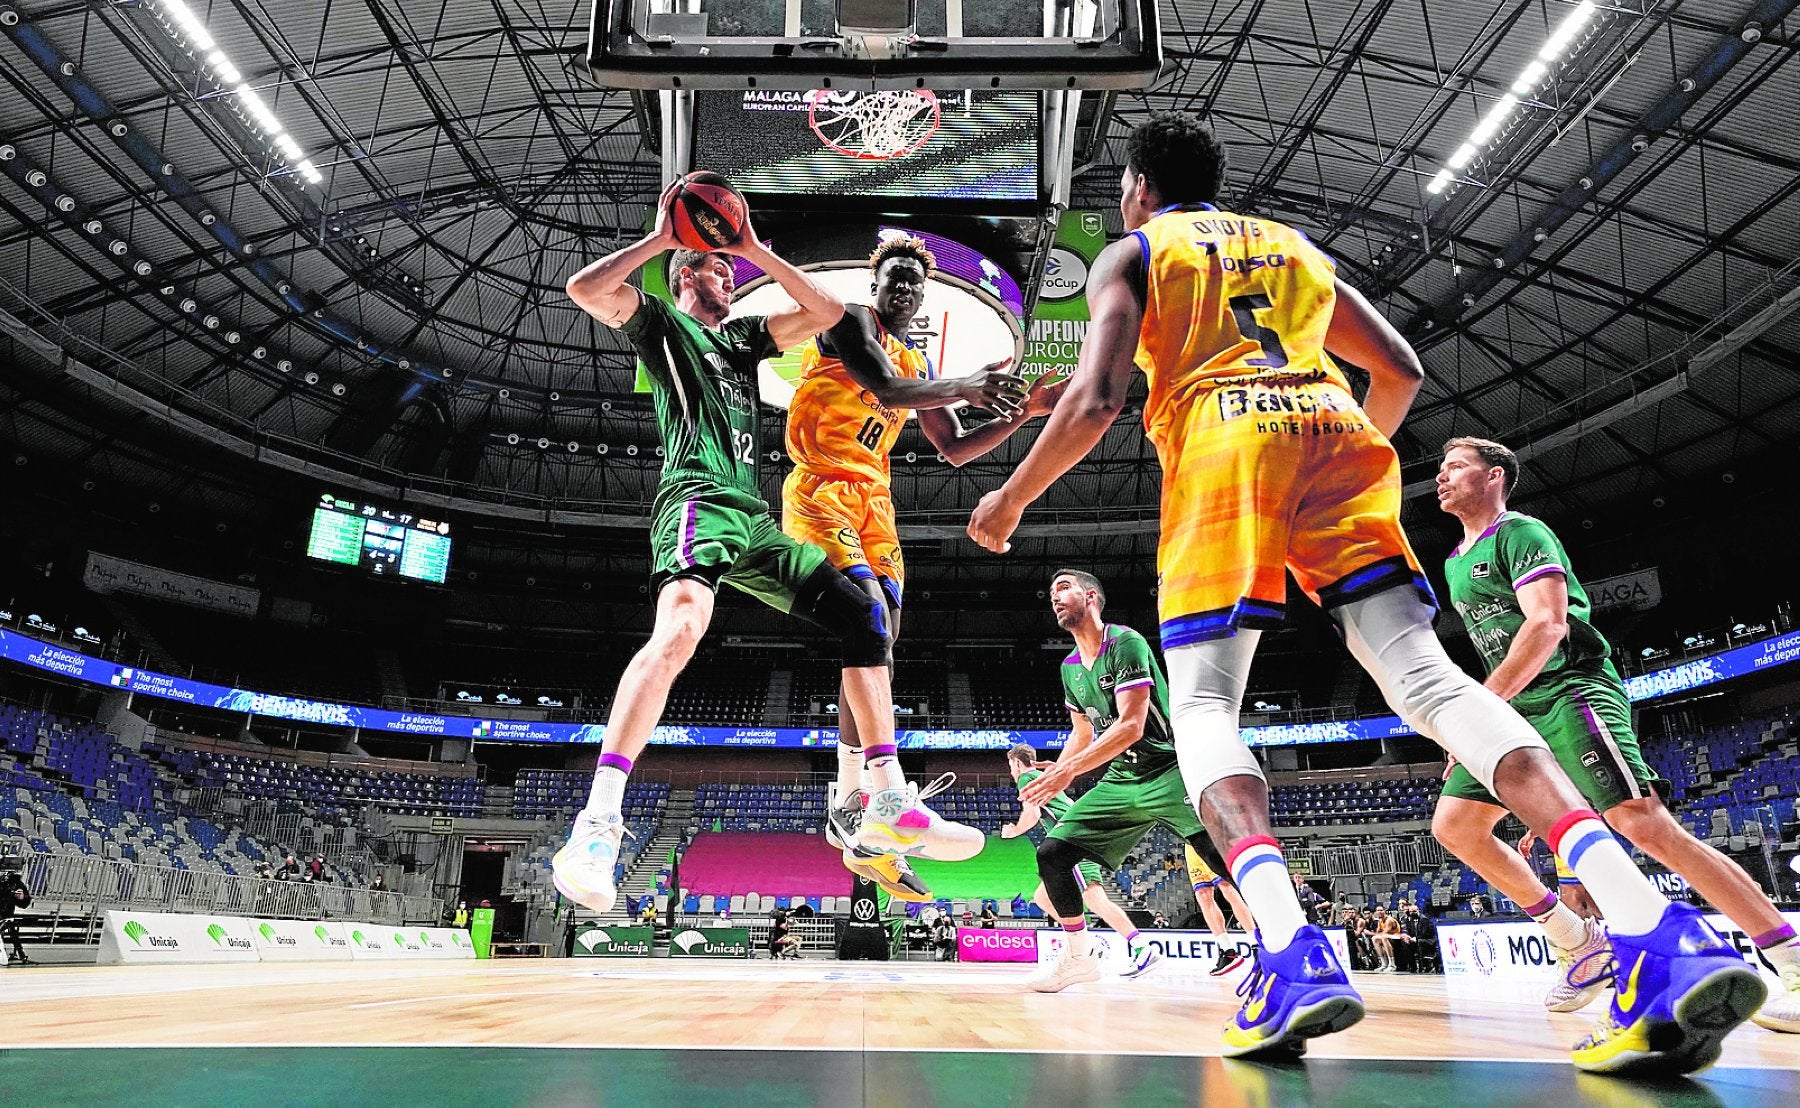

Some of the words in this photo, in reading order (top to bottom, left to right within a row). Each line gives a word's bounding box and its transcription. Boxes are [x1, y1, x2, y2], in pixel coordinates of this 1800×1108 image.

[1192, 219, 1262, 238] OKOYE
[1228, 293, 1289, 368] 5
[856, 416, 885, 452] 18
[731, 426, 755, 466] 32
[1764, 642, 1776, 654] La
[42, 647, 52, 656] La
[53, 650, 85, 667] elección
[1754, 654, 1773, 668] más
[28, 653, 45, 665] más
[45, 656, 83, 676] deportiva
[135, 671, 150, 682] The
[151, 674, 174, 688] most
[132, 681, 166, 696] sportive
[167, 687, 195, 701] choice
[387, 721, 405, 729] más
[406, 722, 444, 734] deportiva
[401, 714, 411, 723] La
[412, 715, 445, 727] elección
[495, 722, 510, 730] The
[511, 723, 529, 732] most
[493, 729, 525, 740] sportive
[526, 731, 551, 740] choice
[747, 729, 776, 737] elección
[822, 730, 836, 738] The
[1057, 731, 1067, 739] La
[1390, 727, 1407, 735] más
[724, 736, 741, 744] más
[741, 736, 776, 745] deportiva
[149, 936, 179, 949] Unicaja
[227, 937, 252, 949] Unicaja
[608, 940, 648, 955] Unicaja
[962, 932, 1035, 949] endesa
[704, 942, 745, 956] Unicaja
[1507, 935, 1557, 966] MOL
